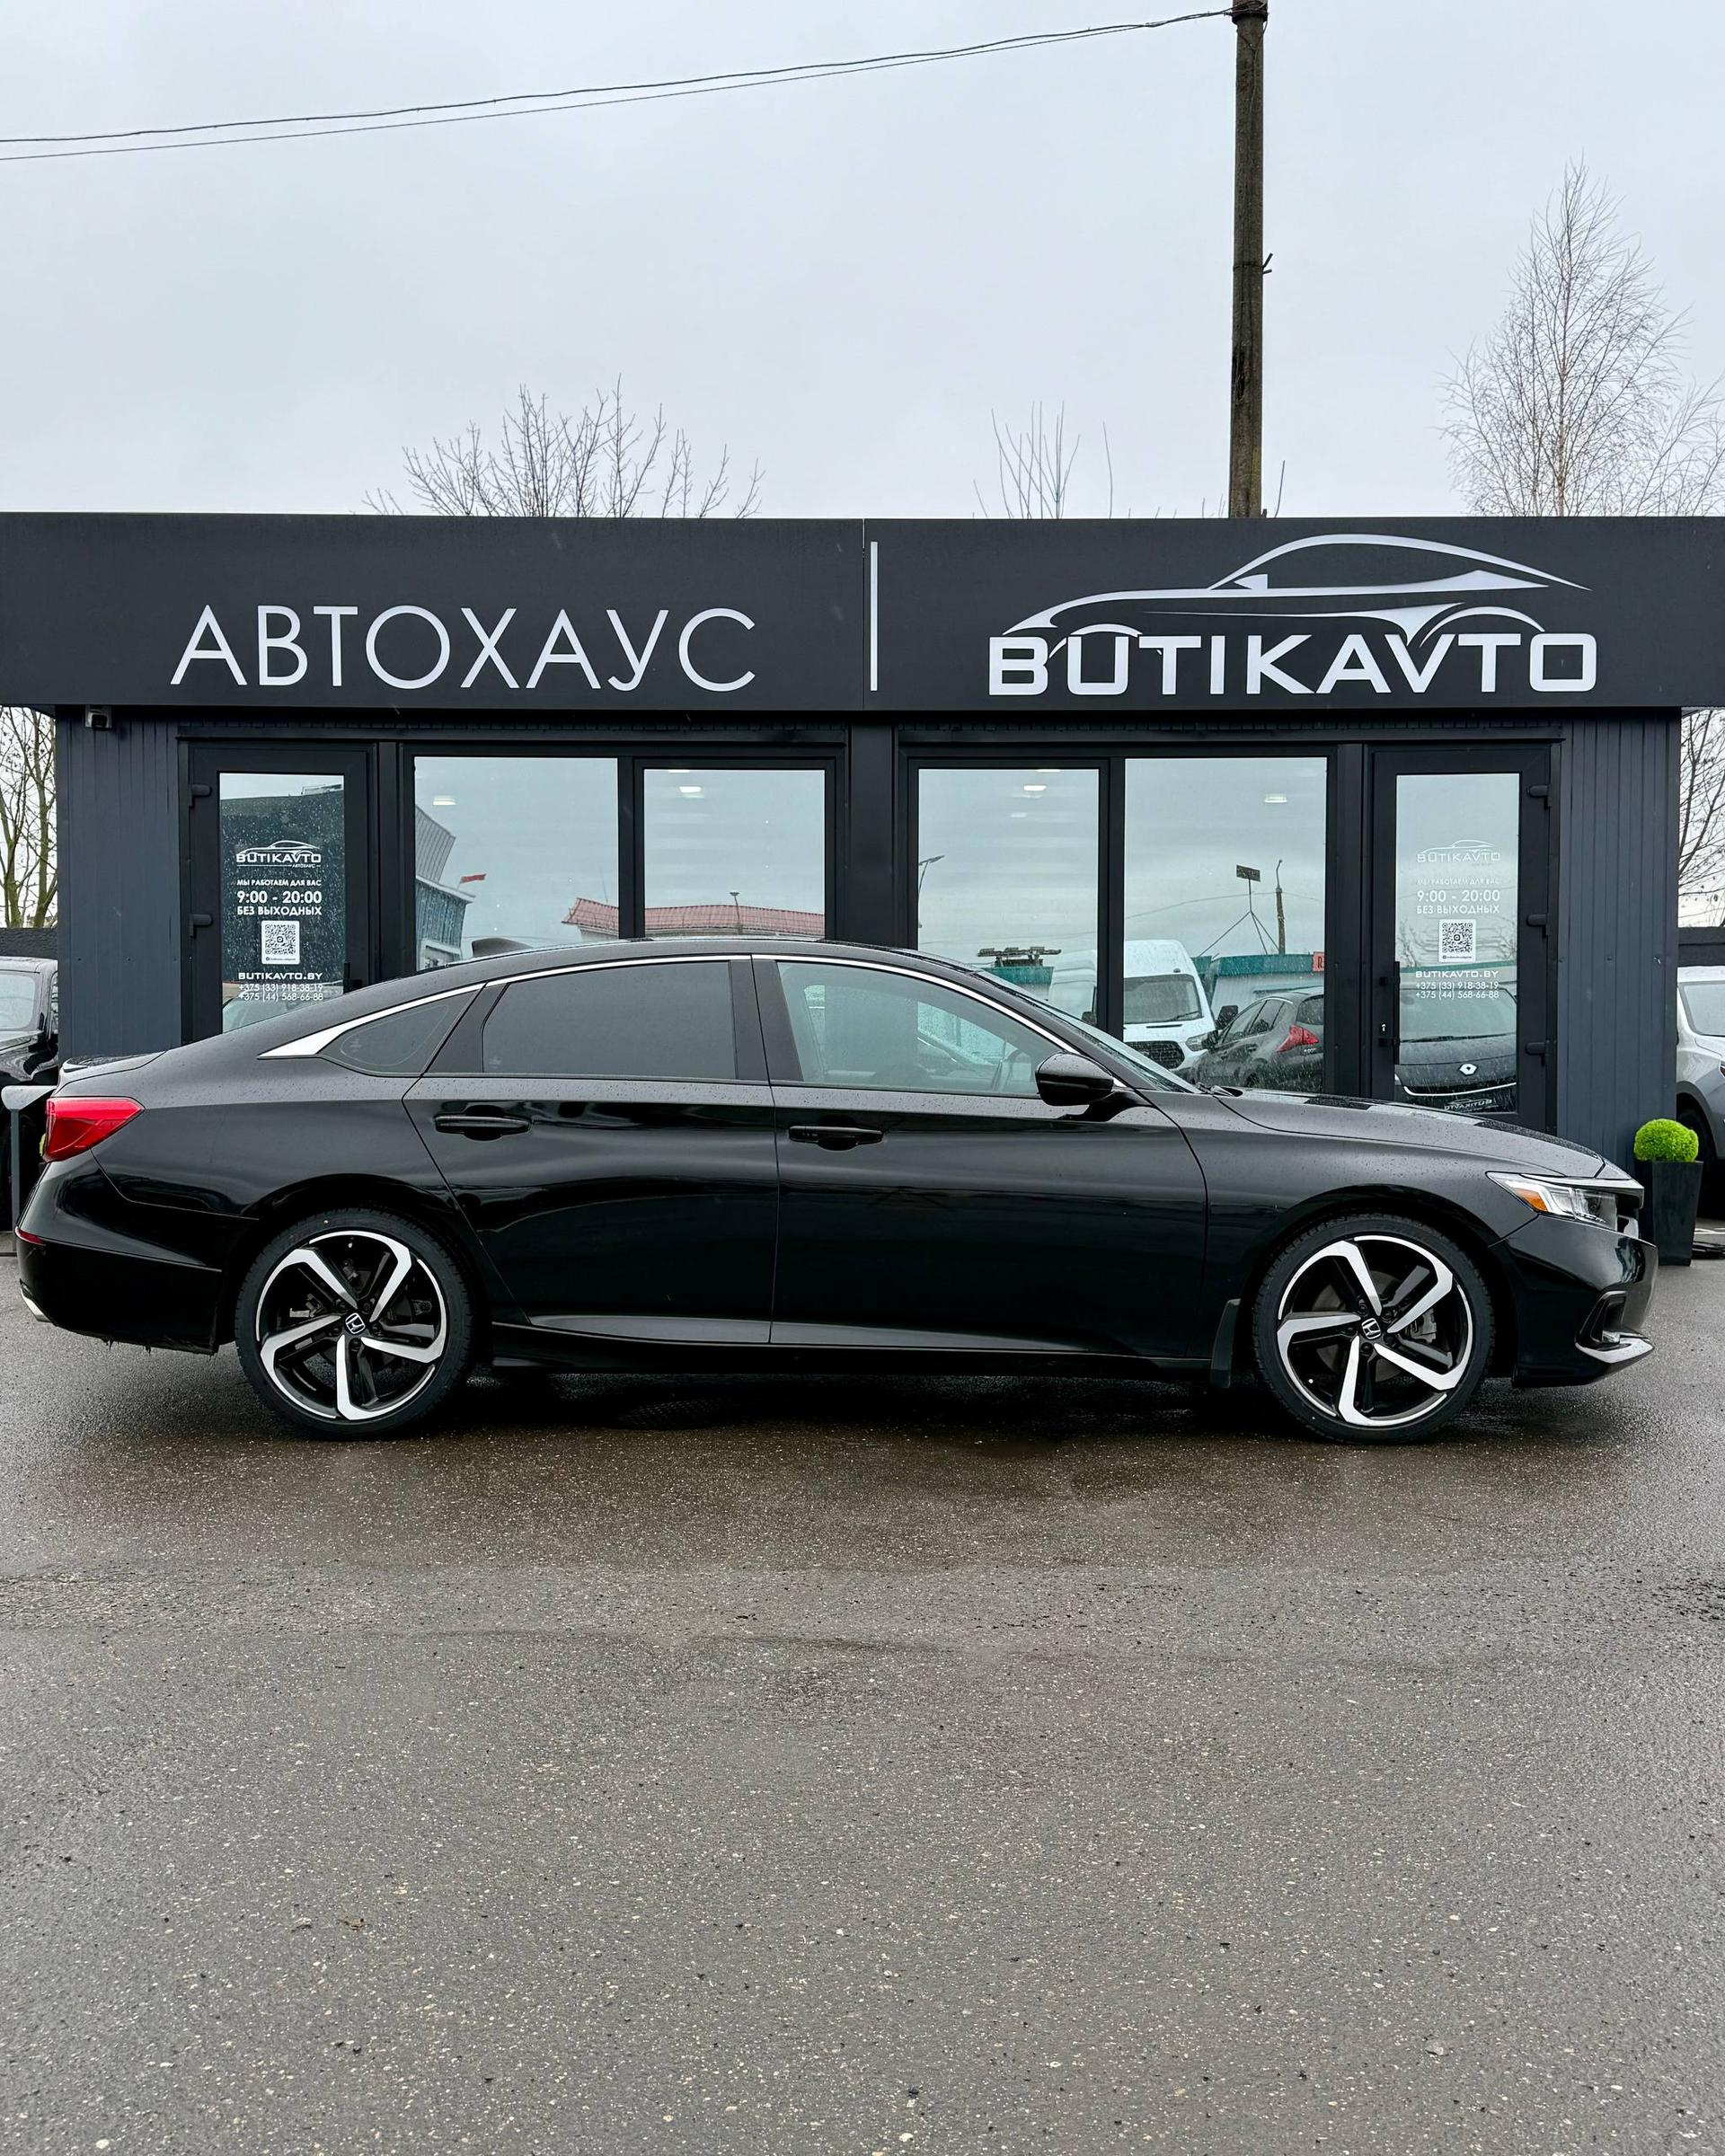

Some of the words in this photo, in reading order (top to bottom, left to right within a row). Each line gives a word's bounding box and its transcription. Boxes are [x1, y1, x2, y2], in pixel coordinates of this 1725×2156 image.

[170, 605, 756, 693] АВТОХАУС
[988, 632, 1597, 696] BUTIKAVTO
[235, 853, 322, 863] BUTIKAVTO
[1417, 853, 1500, 863] BUTIKAVTO
[236, 890, 268, 904] 9:00
[282, 890, 322, 904] 20:00
[1417, 889, 1446, 902] 9:00
[1462, 889, 1500, 902] 20:00
[237, 906, 254, 915] БЕЗ
[257, 906, 323, 916] ВЫХОДНЫХ
[1417, 905, 1434, 915] БЕЗ
[1437, 905, 1500, 915] ВЫХОДНЫХ
[238, 972, 323, 980] BUTIKAVTO.BY
[1415, 970, 1499, 978] BUTIKAVTO.BY
[262, 983, 279, 993] (33)
[281, 984, 323, 992] 918-38-19
[1416, 982, 1437, 990] +375
[1438, 981, 1455, 992] (33)
[1457, 981, 1499, 990] 918-38-19
[239, 993, 260, 1001] +375
[262, 993, 279, 1003] (44)
[281, 993, 323, 1001] 568-66-88
[1416, 991, 1437, 999] +375
[1438, 990, 1455, 1000] (44)
[1457, 991, 1499, 999] 568-66-88
